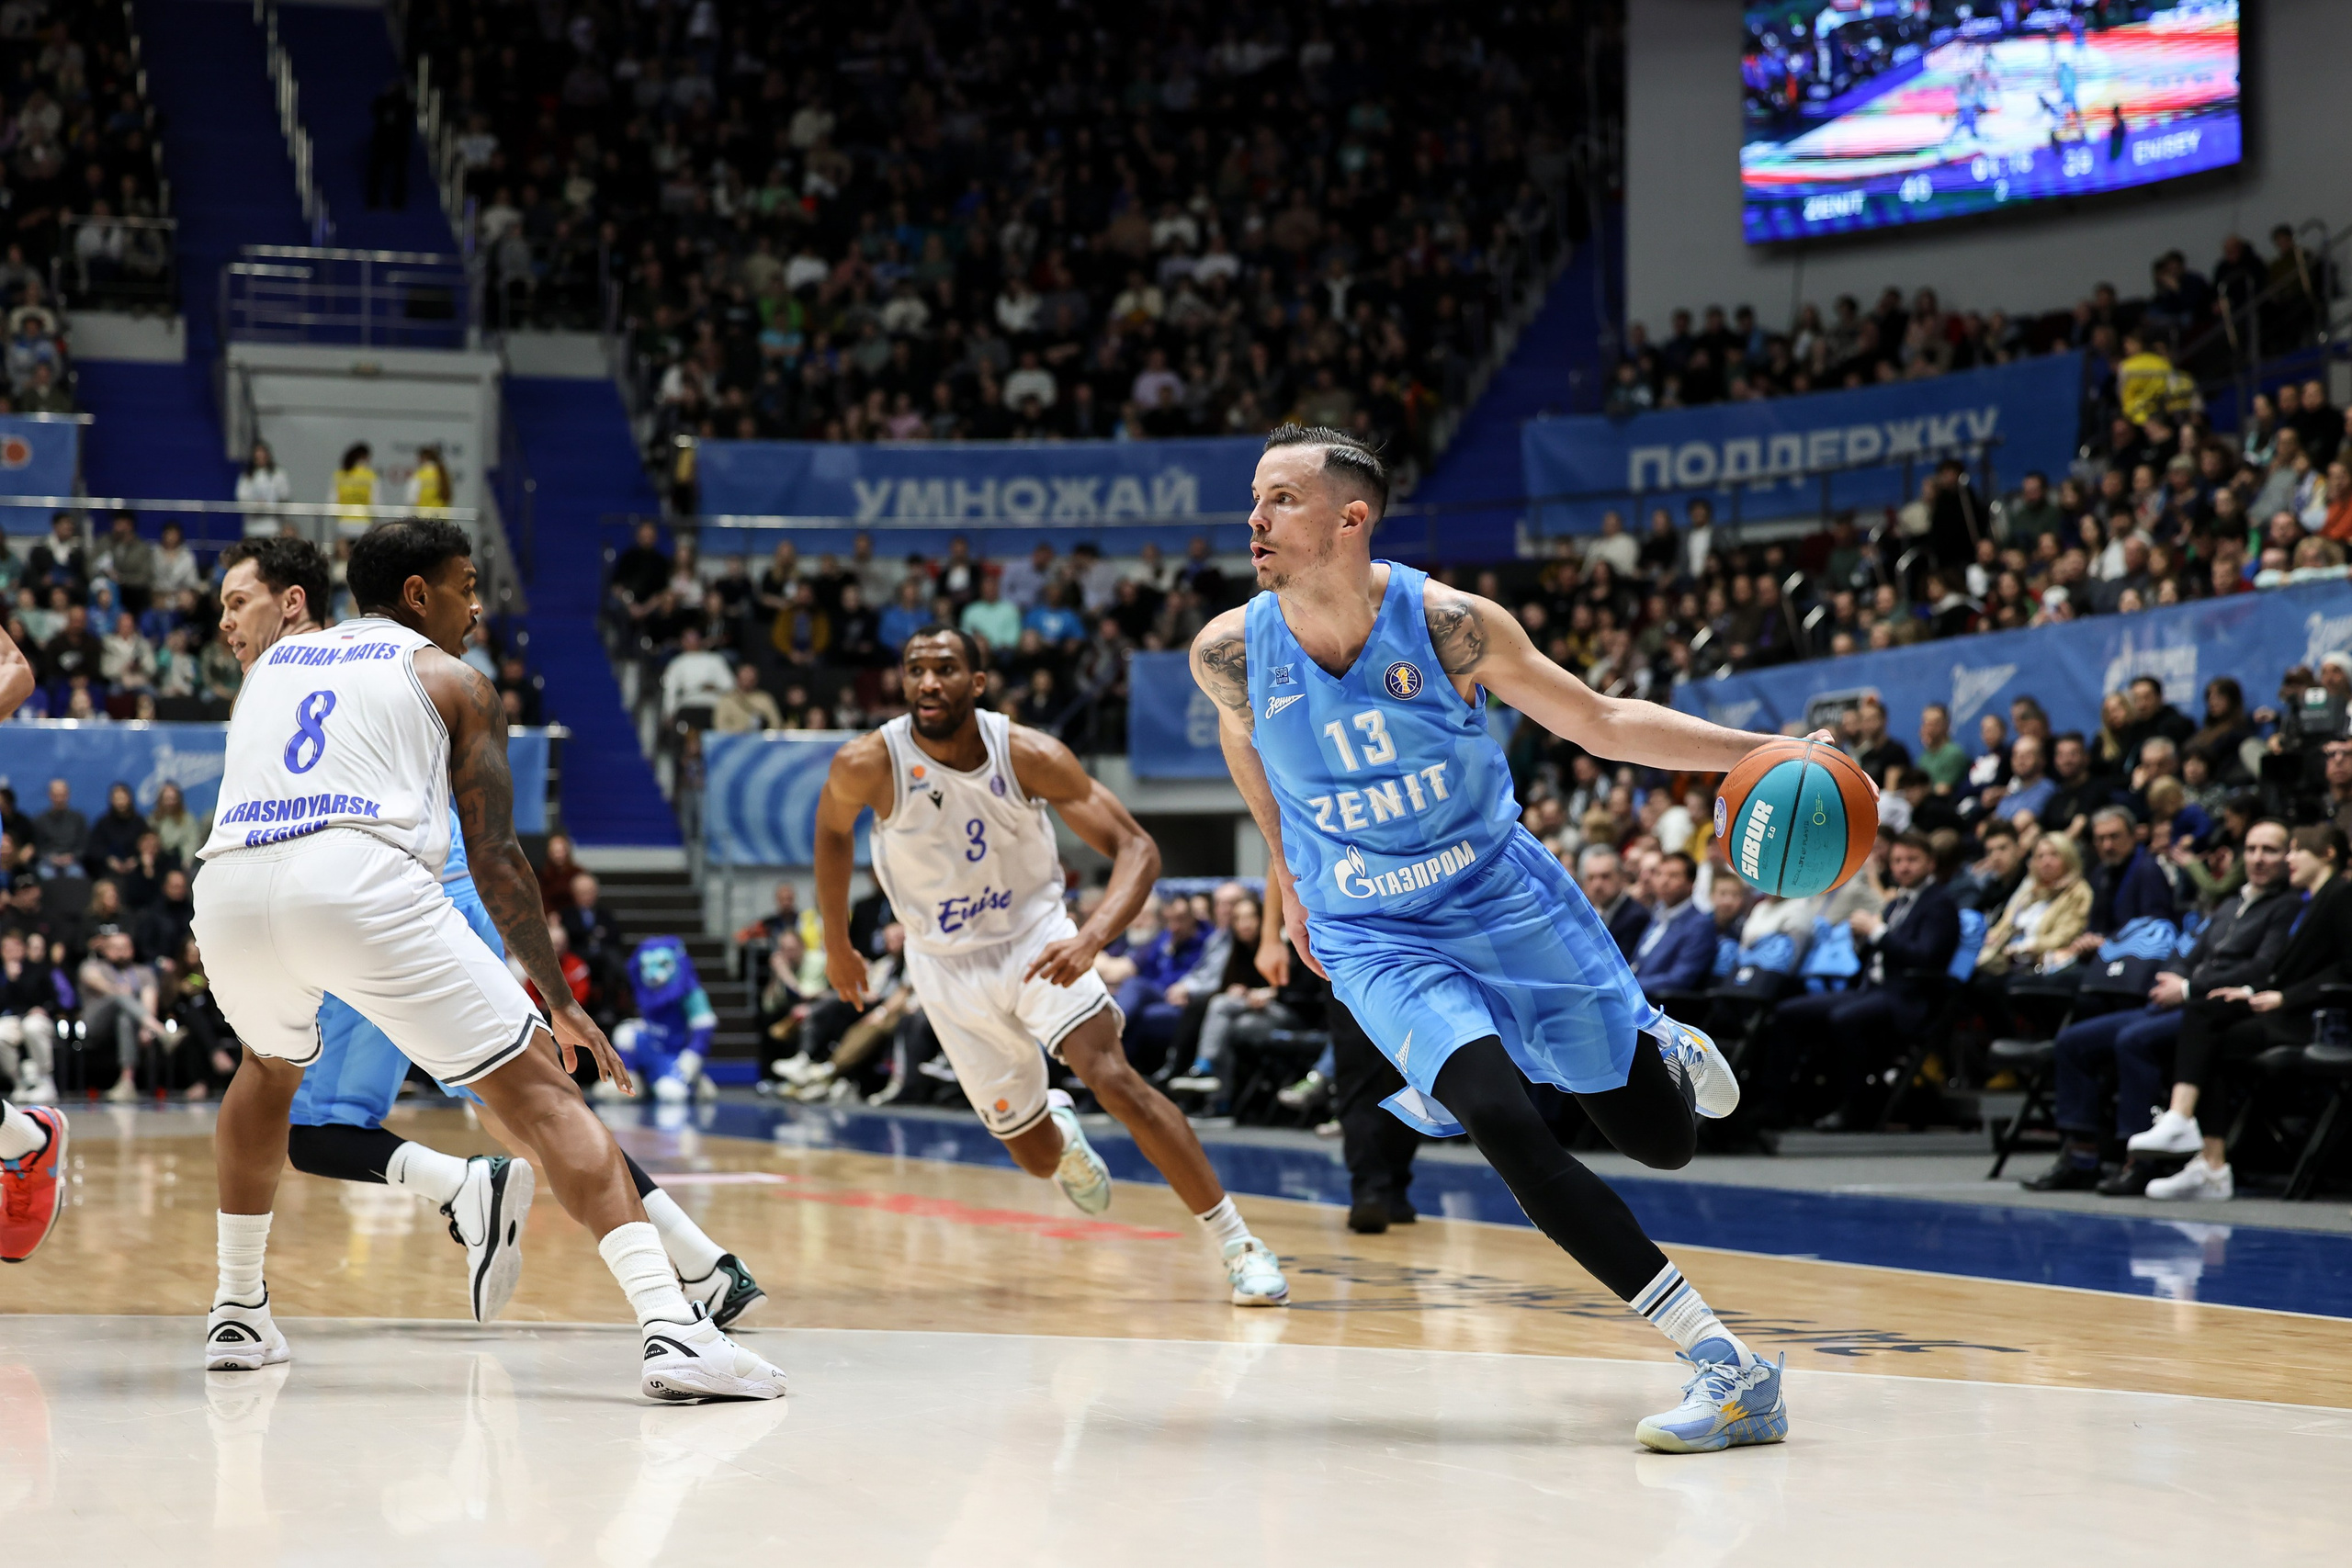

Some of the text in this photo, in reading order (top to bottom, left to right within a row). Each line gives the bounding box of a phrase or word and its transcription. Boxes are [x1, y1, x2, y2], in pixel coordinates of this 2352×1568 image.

[1628, 405, 1999, 494] ПОДДЕРЖКУ
[853, 466, 1197, 525] УМНОЖАЙ
[268, 642, 401, 666] RATHAN-MAYES
[284, 690, 336, 774] 8
[1323, 709, 1396, 772] 13
[220, 794, 381, 827] KRASNOYARSK
[1306, 759, 1450, 833] ZENIT
[966, 818, 987, 862] 3
[1741, 799, 1774, 880] SIBUR
[1767, 826, 1777, 840] 2.0
[1376, 840, 1476, 897] ГАЗПРОМ
